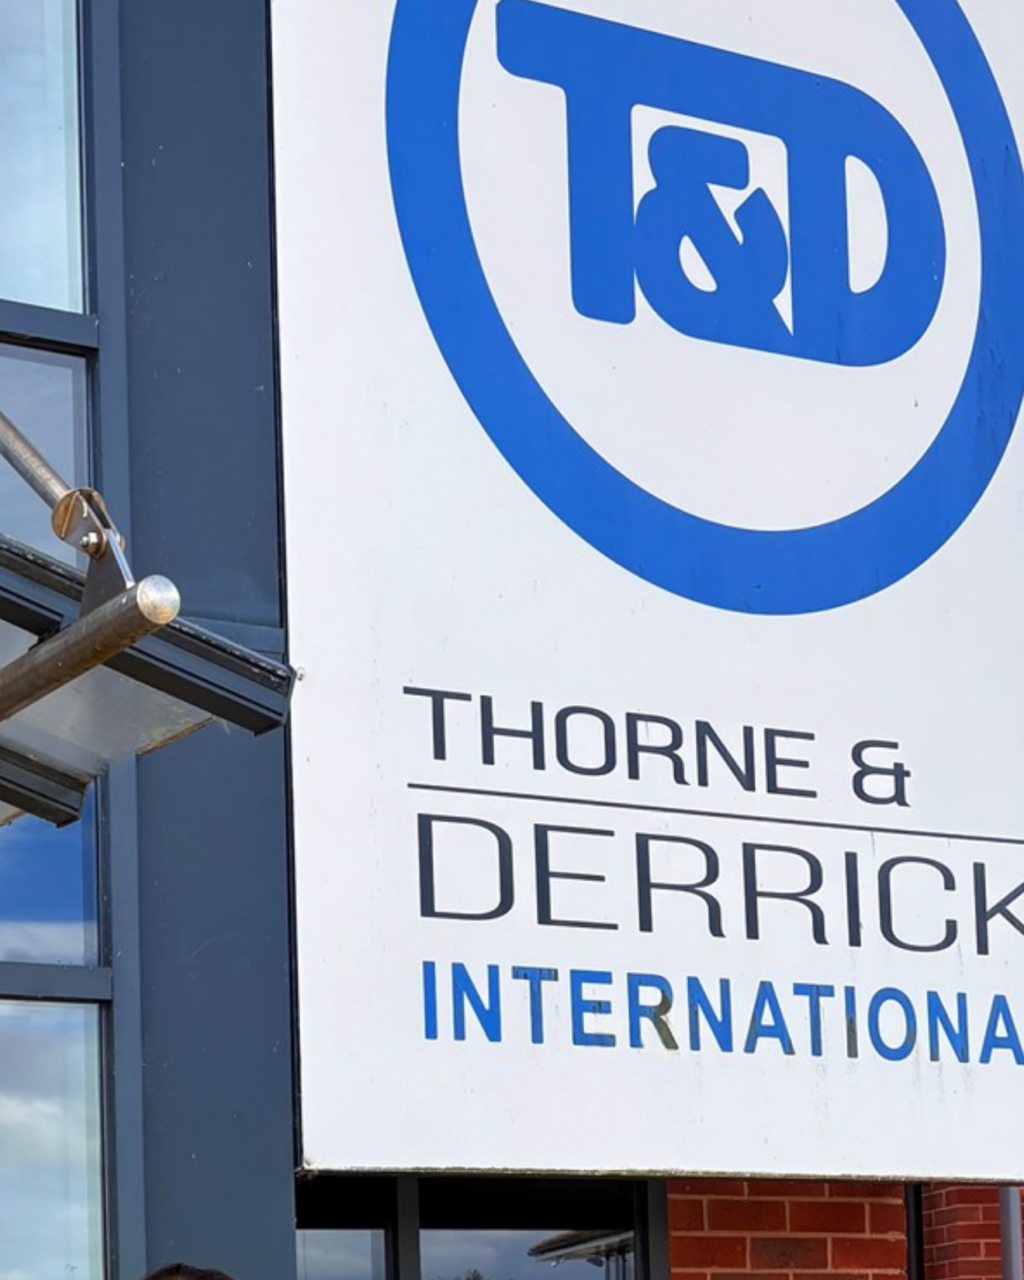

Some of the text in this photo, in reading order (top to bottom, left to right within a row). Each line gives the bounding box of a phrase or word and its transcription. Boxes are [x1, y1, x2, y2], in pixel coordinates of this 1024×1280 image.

[496, 0, 946, 367] T&D
[403, 686, 911, 808] THORNE &
[417, 812, 1024, 956] DERRICK
[422, 960, 1024, 1066] INTERNATIONA
